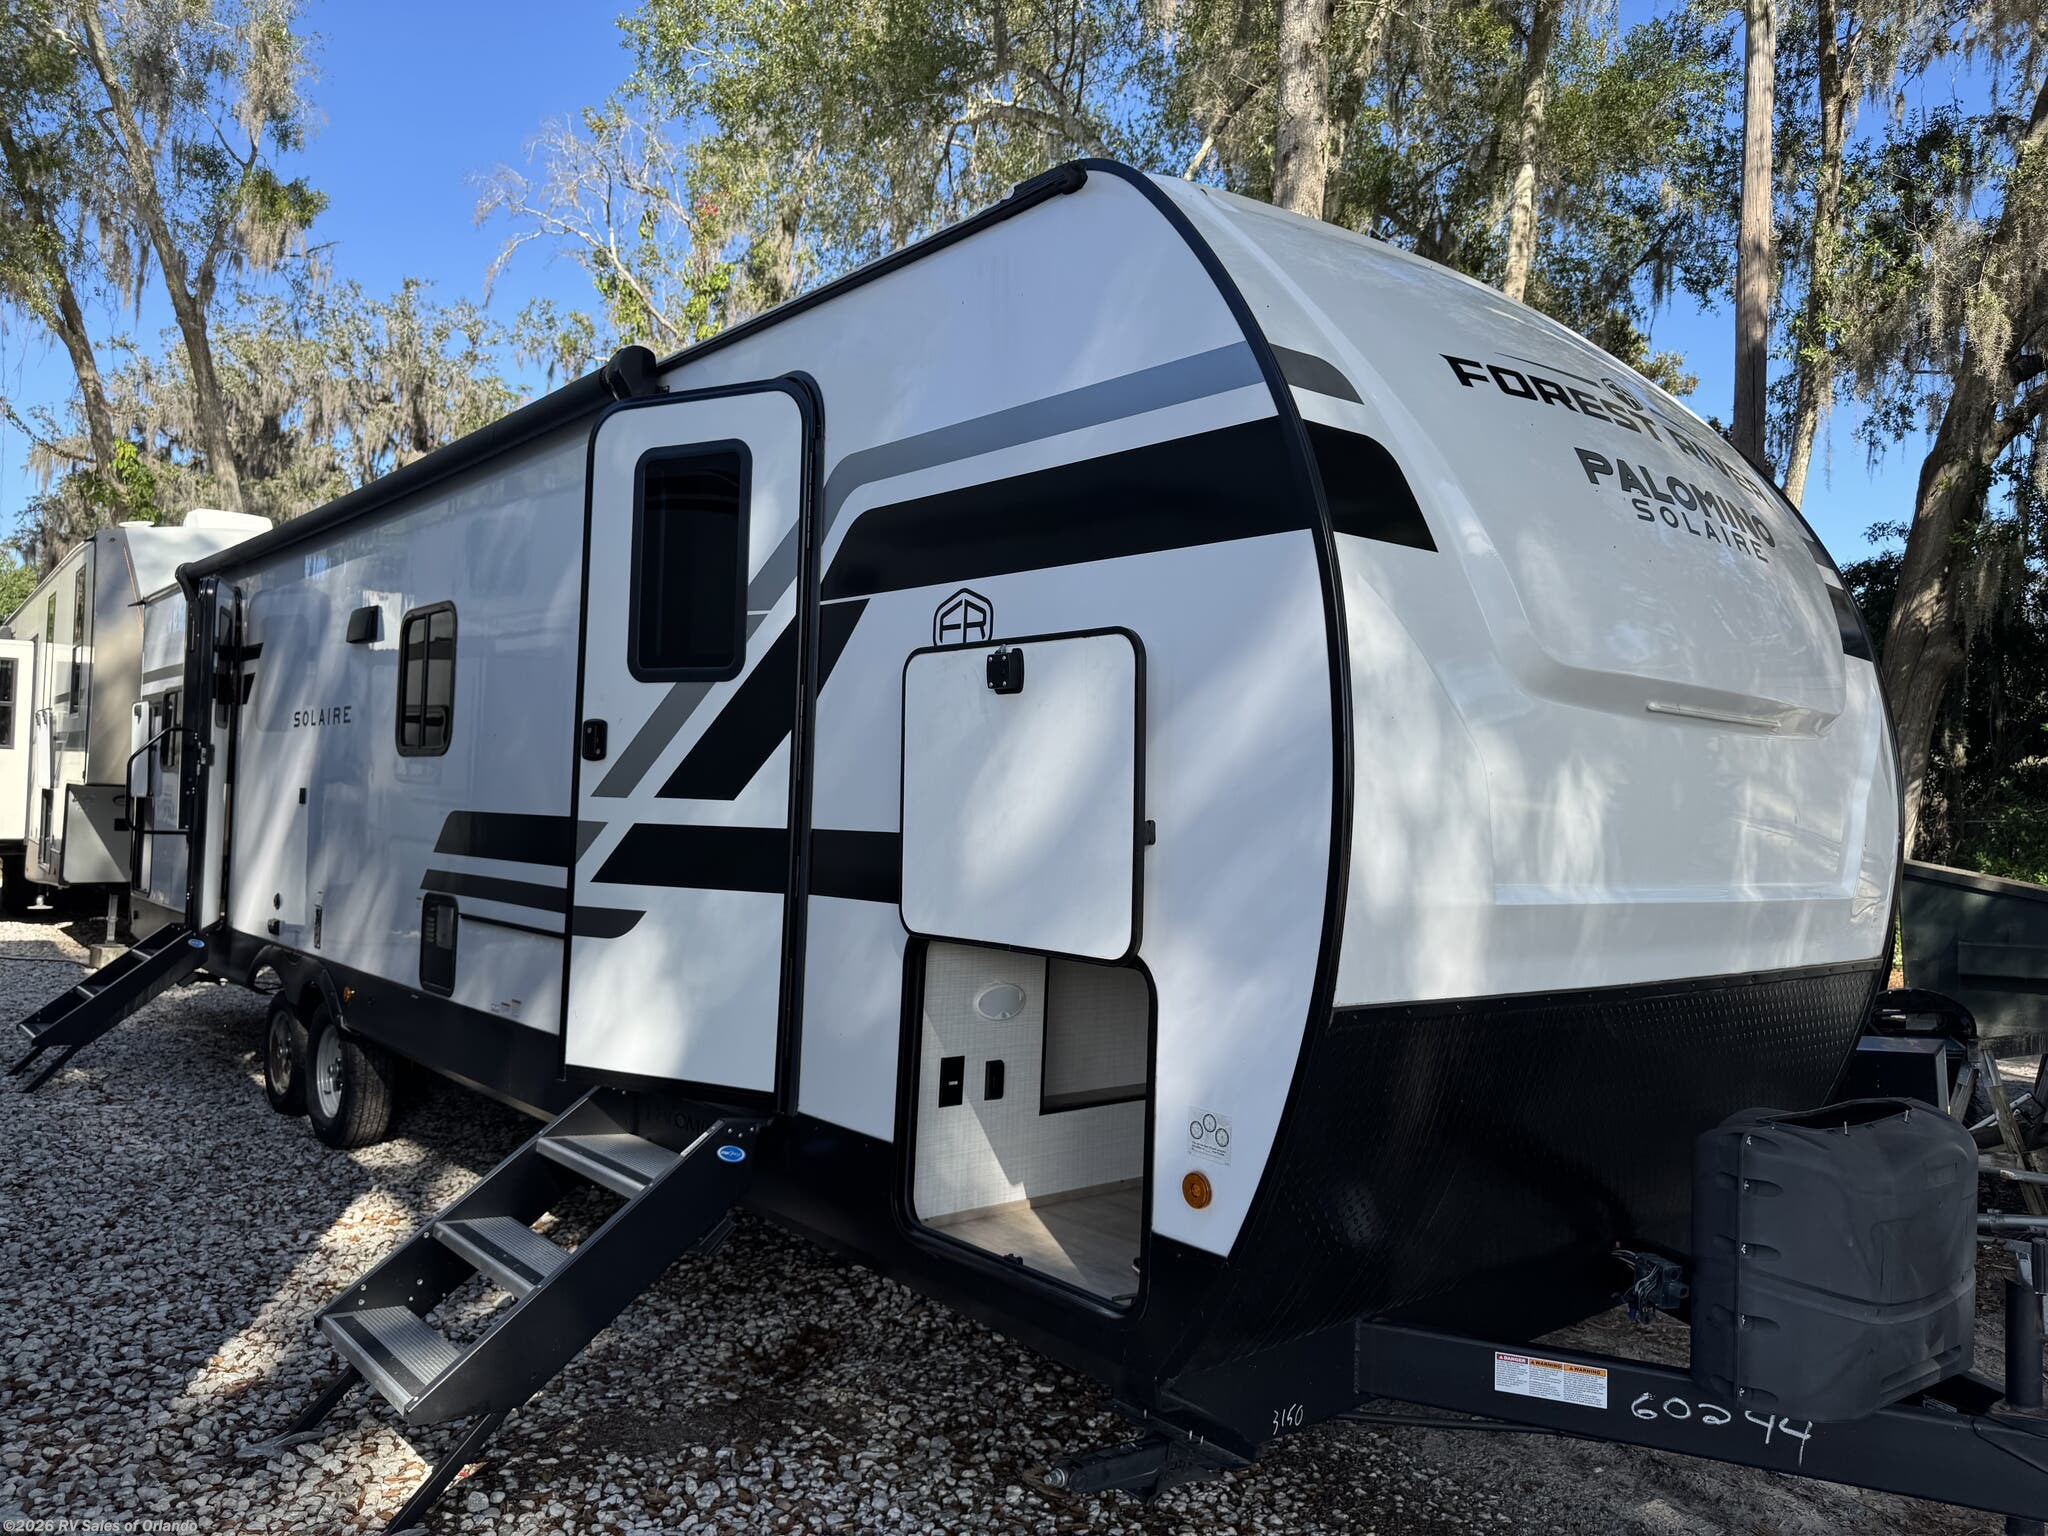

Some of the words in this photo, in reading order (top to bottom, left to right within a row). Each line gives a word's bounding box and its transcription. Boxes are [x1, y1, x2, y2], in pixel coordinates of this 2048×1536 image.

[1439, 353, 1662, 442] FOREST
[1574, 447, 1776, 548] PALOMINO
[1631, 498, 1769, 563] SOLAIRE
[293, 706, 352, 728] SOLAIRE
[1503, 1355, 1526, 1363] DANGER
[1535, 1361, 1562, 1369] WARNING
[1574, 1367, 1601, 1376] WARNING
[1631, 1392, 1813, 1467] 60244
